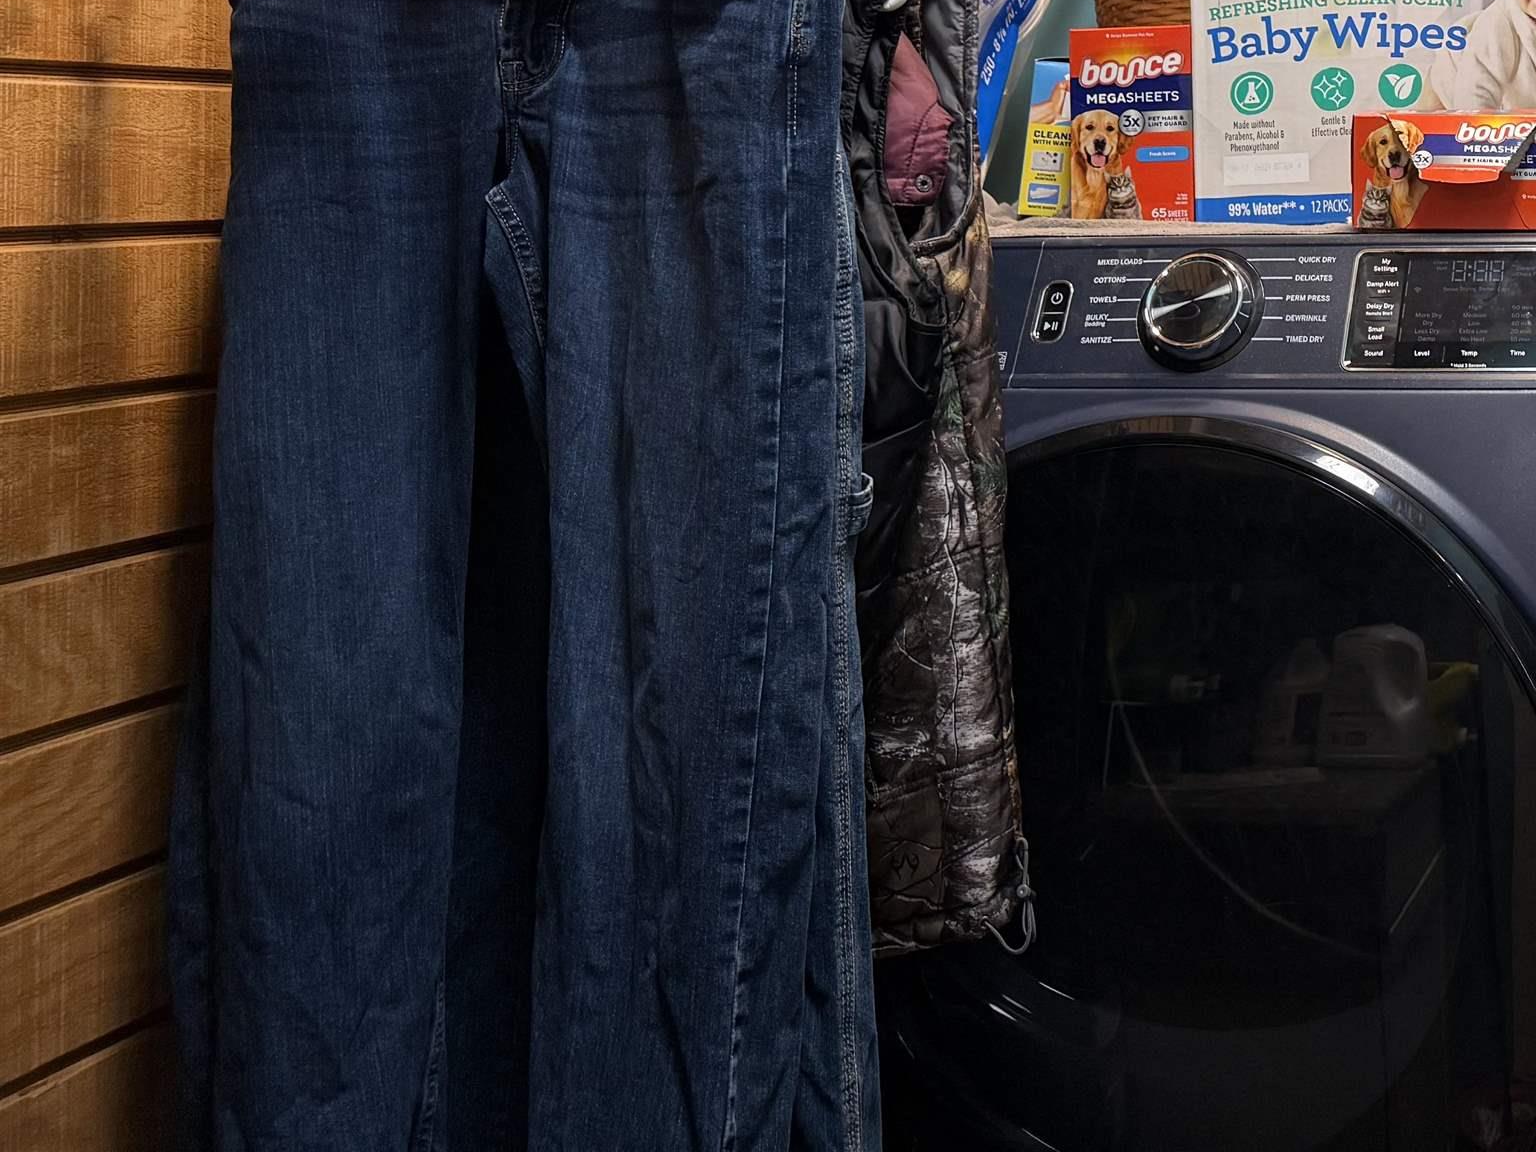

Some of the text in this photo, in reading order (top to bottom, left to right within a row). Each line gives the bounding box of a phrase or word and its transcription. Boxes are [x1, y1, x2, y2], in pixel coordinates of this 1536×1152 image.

[1206, 10, 1468, 65] Baby Wipes
[980, 57, 996, 87] 250
[1079, 50, 1184, 89] bounce
[1085, 90, 1180, 105] MEGASHEETS
[1233, 119, 1275, 129] Made without
[1321, 116, 1340, 126] Gentle
[1224, 130, 1280, 142] Parabens, Alcohol
[1311, 127, 1339, 138] Effective
[1032, 138, 1052, 147] WITH
[1230, 141, 1280, 154] Phenoxyethanol
[1228, 202, 1251, 217] 99%
[1311, 200, 1321, 214] 12
[1322, 198, 1352, 214] PACKS,
[1151, 207, 1188, 219] 65 SHEETS
[1097, 258, 1143, 266] MIXED LOADS
[1298, 256, 1337, 264] QUICK DRY
[1373, 265, 1398, 273] Settings
[1093, 276, 1127, 284] COTTONS
[1295, 274, 1333, 282] DELICATES
[1366, 280, 1384, 288] Damp
[1089, 296, 1117, 304] TOWELS
[1285, 294, 1331, 302] PERM PRESS
[1366, 302, 1383, 310] Delay
[1285, 314, 1328, 322] DEWRINKLE
[1081, 336, 1113, 344] SANITIZE
[1285, 335, 1325, 343] TIMED DRY
[1367, 333, 1383, 341] Load
[1363, 349, 1384, 357] Sound
[1413, 349, 1431, 357] Level
[1460, 349, 1479, 358] Temp
